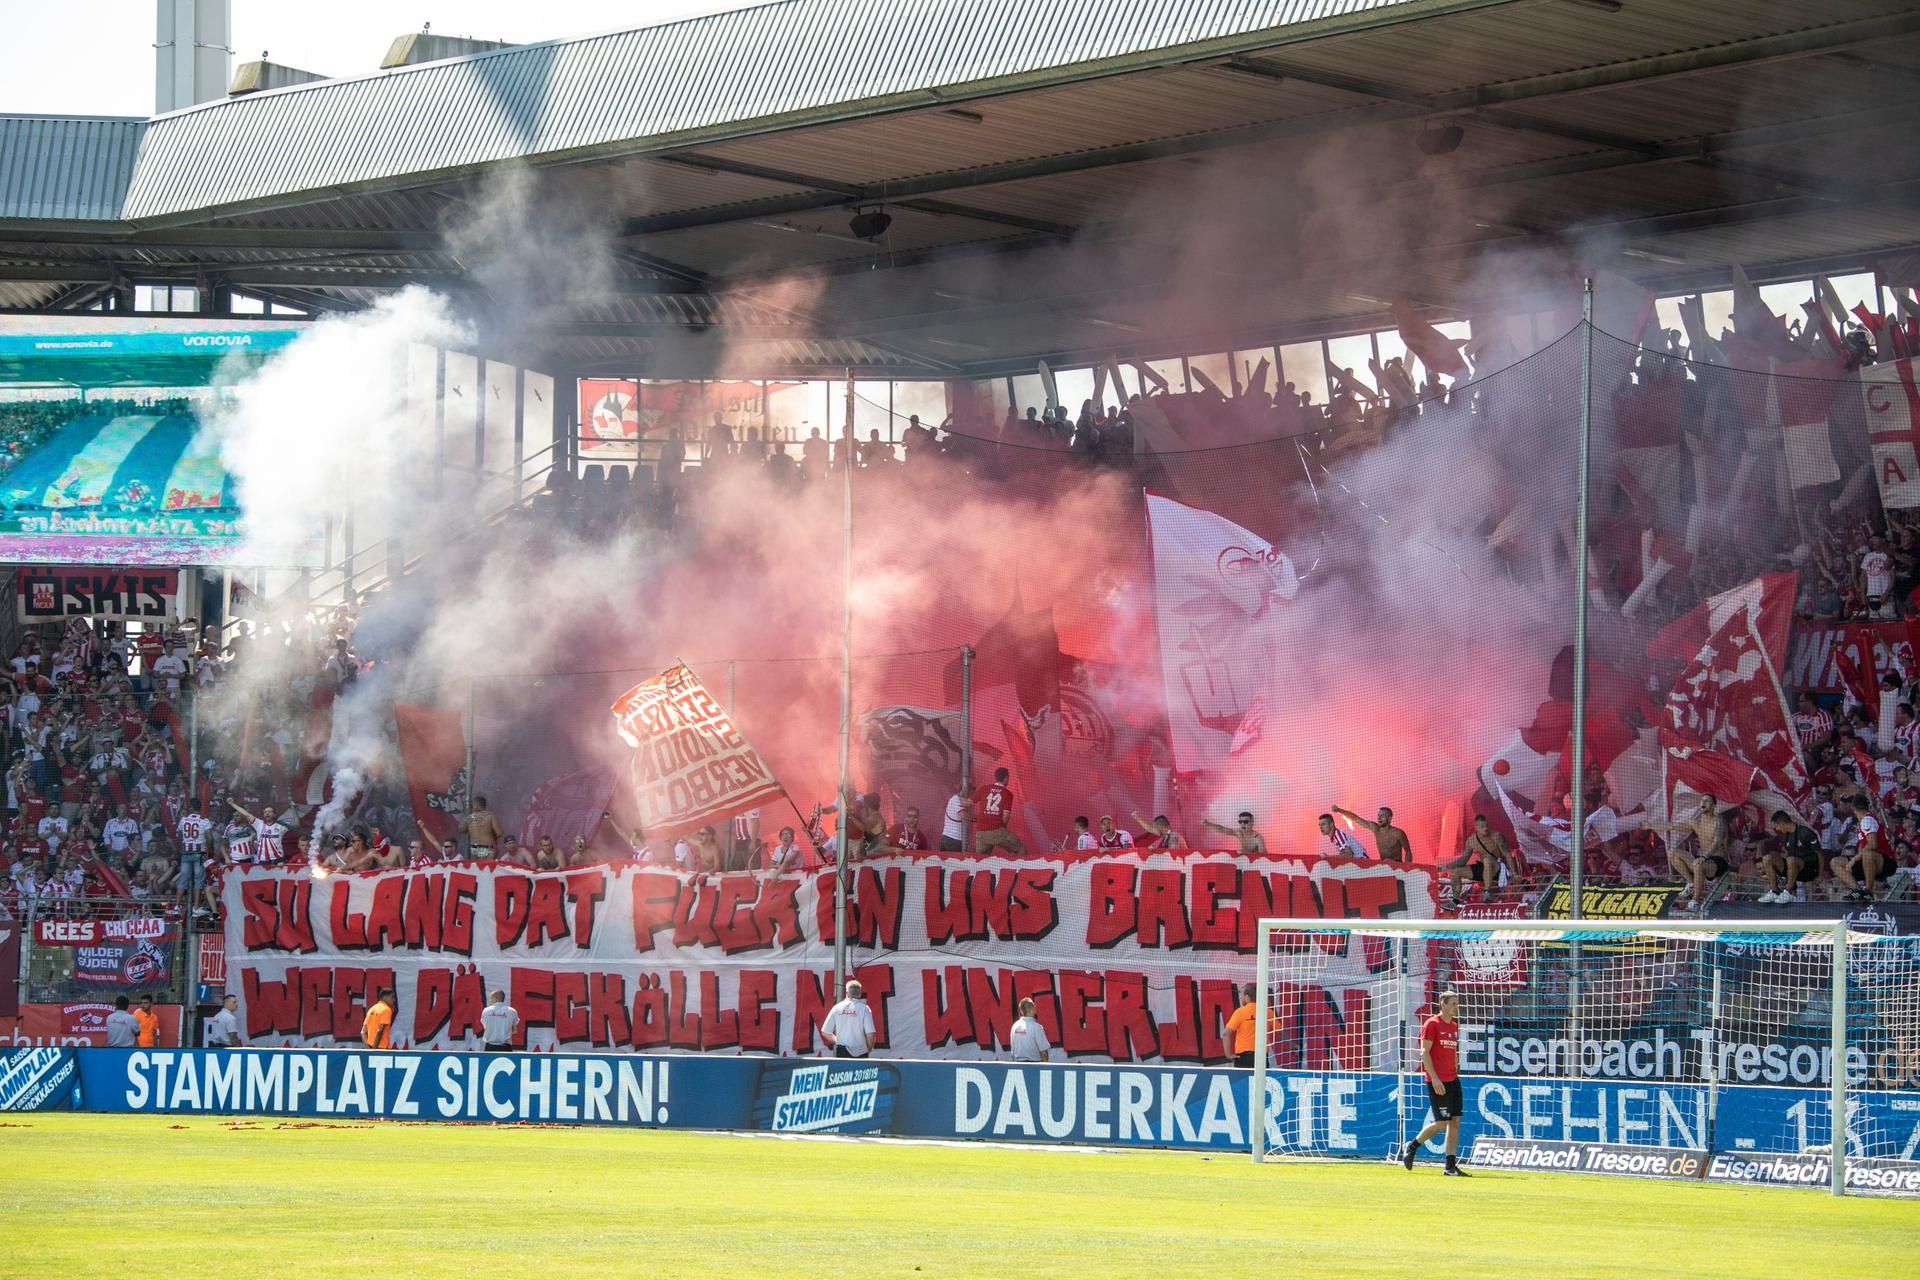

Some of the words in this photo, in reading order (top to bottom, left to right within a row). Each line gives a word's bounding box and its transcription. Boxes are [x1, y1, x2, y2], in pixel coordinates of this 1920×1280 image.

[986, 793, 1002, 811] 12
[183, 822, 199, 840] 96
[42, 922, 95, 941] REES
[242, 877, 317, 952] SU
[330, 872, 477, 956] LANG
[495, 872, 605, 949] DAT
[816, 866, 906, 950] EN
[925, 866, 1058, 946] UNS
[1086, 863, 1407, 974] BRENNT
[413, 962, 486, 1046] DÄ
[792, 963, 895, 1054] NT
[921, 966, 1371, 1070] UNGERJON
[1459, 1024, 1681, 1078] Eisenbach
[126, 1051, 421, 1115] STAMMPLATZ
[437, 1056, 669, 1124] SICHERN!
[793, 1071, 824, 1095] MEIN
[828, 1071, 853, 1086] SAISON
[853, 1067, 879, 1082] 2018/19
[777, 1088, 874, 1129] STAMMPLATZ
[955, 1067, 1357, 1149] DAUERKARTE
[1470, 1142, 1580, 1168] Eisenbach
[1585, 1147, 1697, 1176] Tresore.de
[1709, 1155, 1829, 1183] Eisenbach
